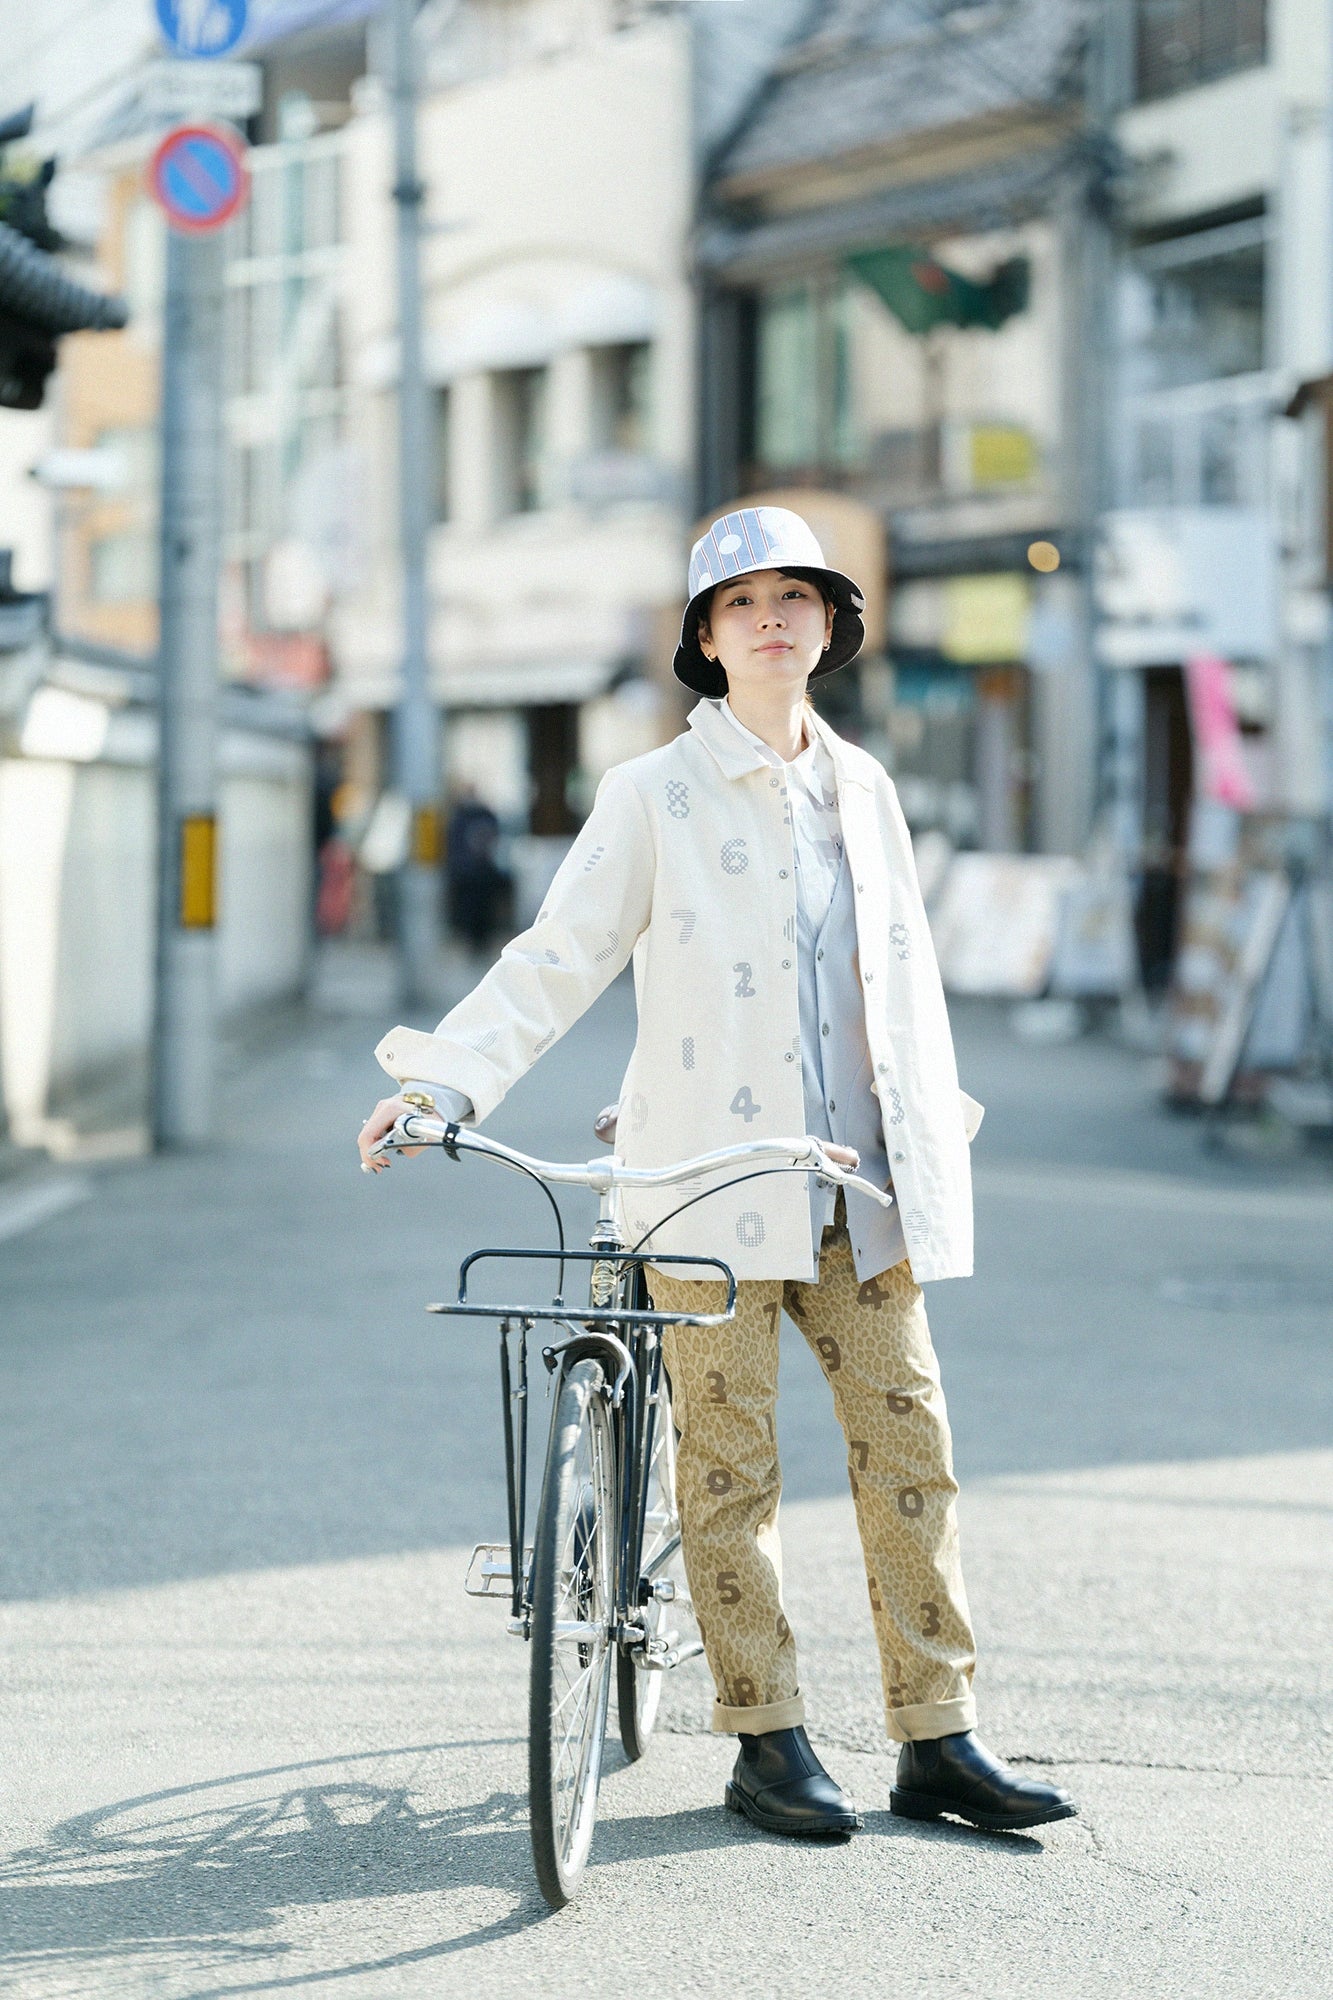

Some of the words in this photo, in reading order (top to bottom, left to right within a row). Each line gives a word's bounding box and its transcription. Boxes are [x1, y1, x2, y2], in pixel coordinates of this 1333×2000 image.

[720, 838, 749, 875] 6
[670, 909, 697, 945] 7
[733, 962, 756, 998] 2
[729, 1085, 762, 1123] 4
[736, 1211, 766, 1248] 0
[857, 1278, 890, 1310] 4
[816, 1336, 841, 1372] 9
[886, 1387, 914, 1416] 6
[851, 1441, 869, 1471] 7
[898, 1486, 924, 1518] 0
[716, 1571, 742, 1605] 5
[920, 1602, 941, 1637] 3
